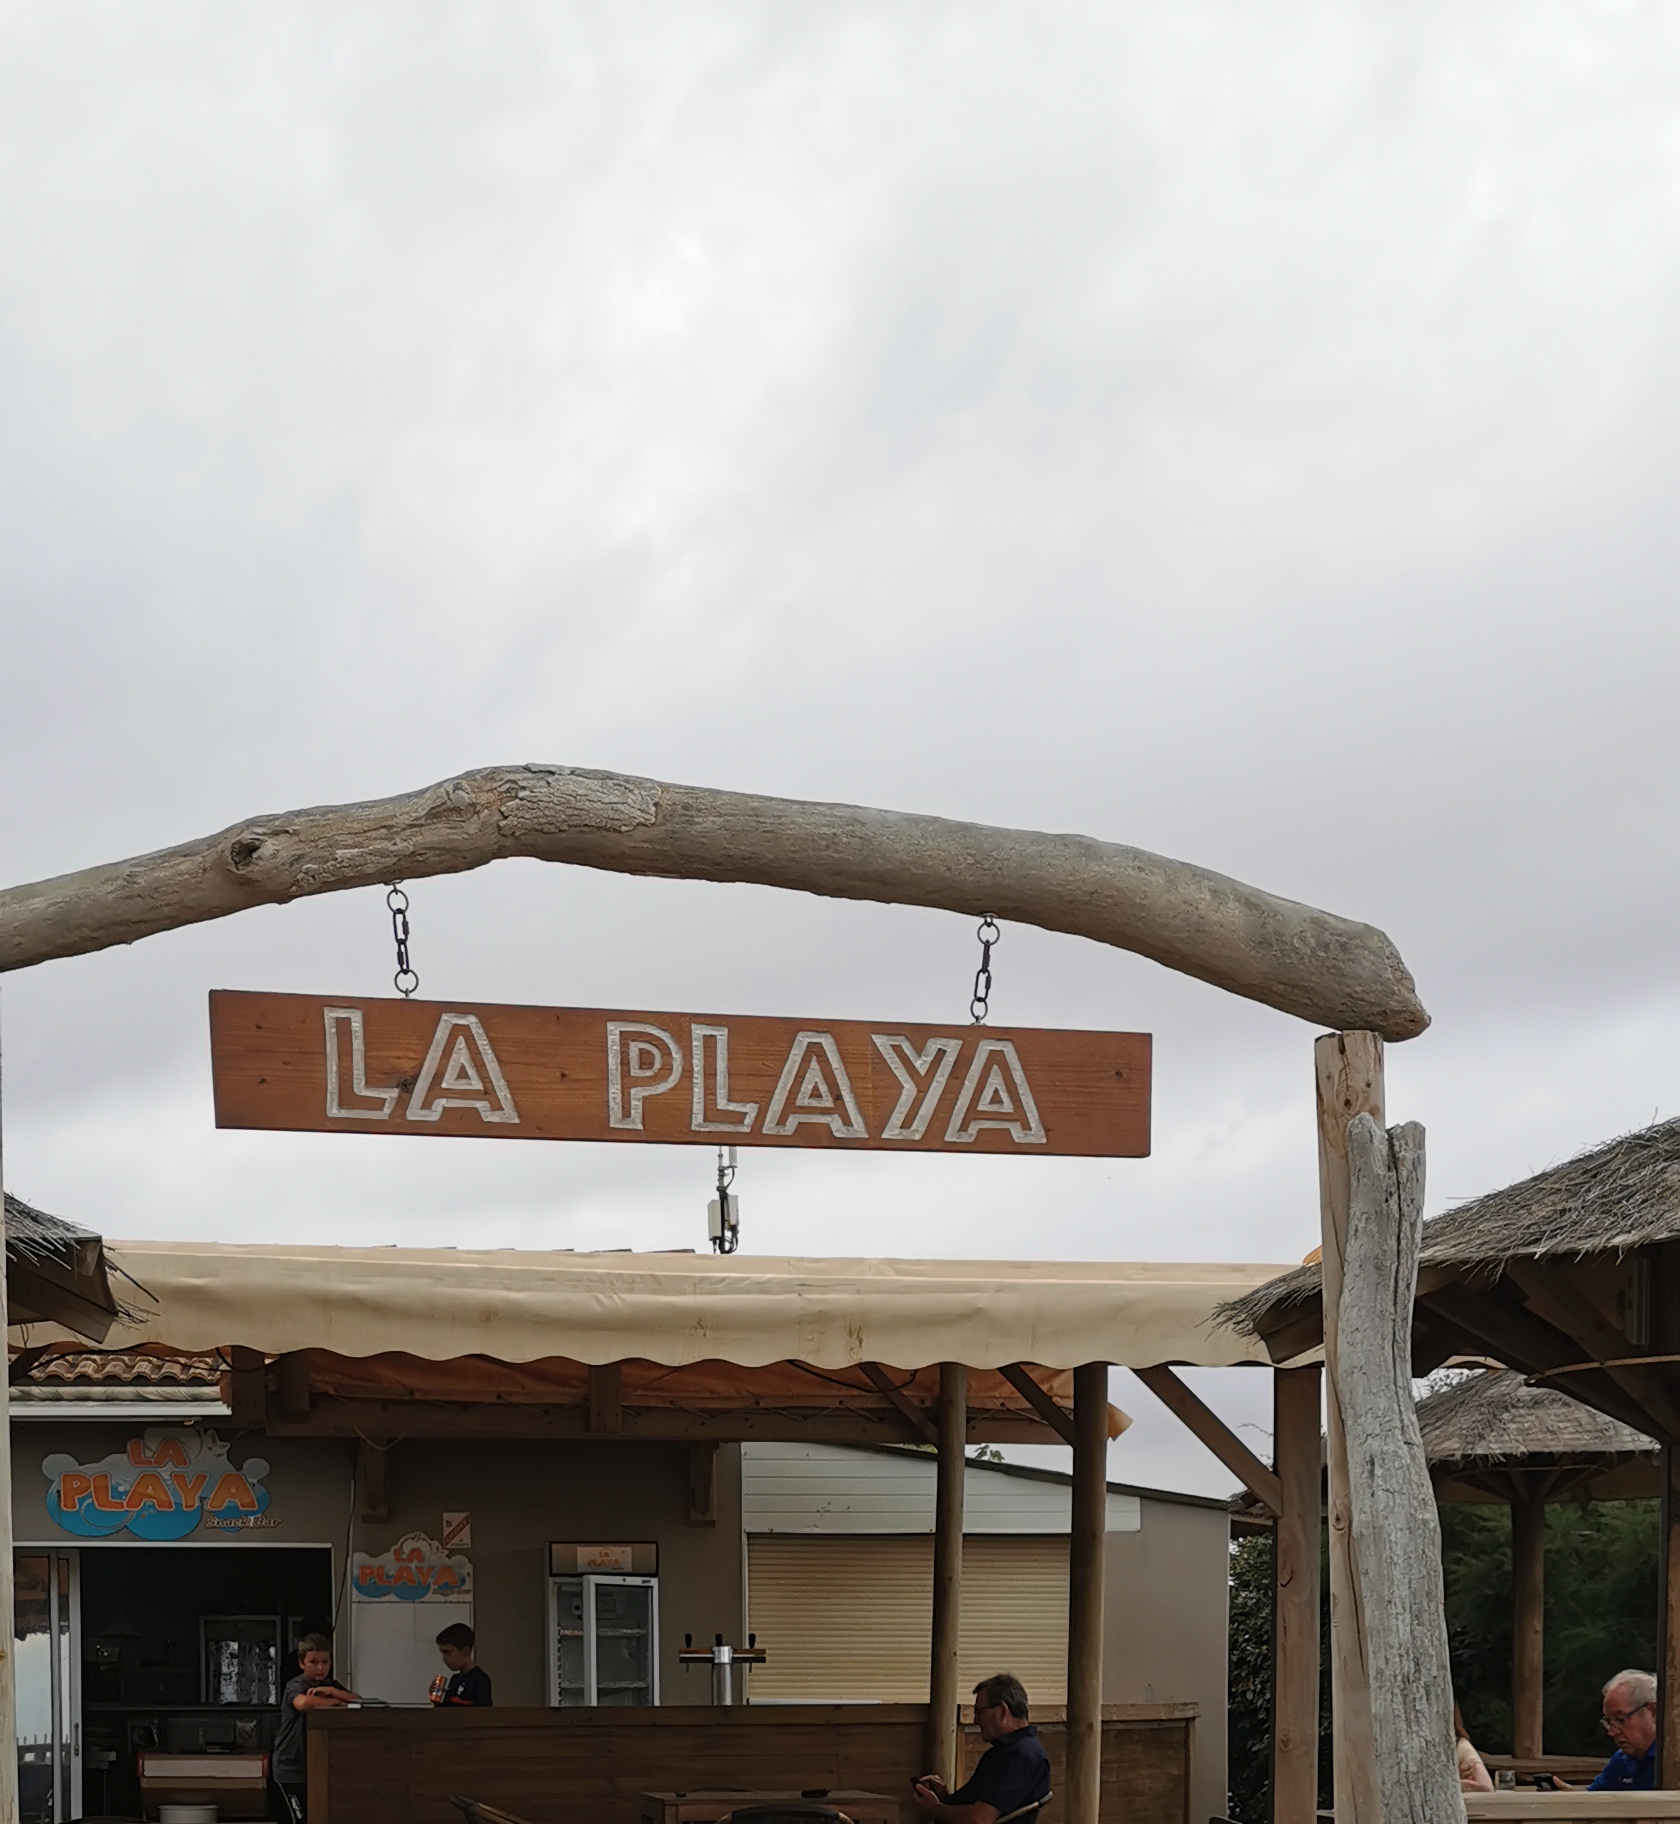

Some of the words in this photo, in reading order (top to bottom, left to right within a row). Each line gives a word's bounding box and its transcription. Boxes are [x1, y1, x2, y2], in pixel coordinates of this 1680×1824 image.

[323, 1006, 521, 1124] LA
[606, 1020, 1048, 1144] PLAYA
[127, 1438, 190, 1467] LA
[60, 1472, 259, 1512] PLAYA
[393, 1547, 425, 1563] LA
[359, 1565, 460, 1587] PLAYA
